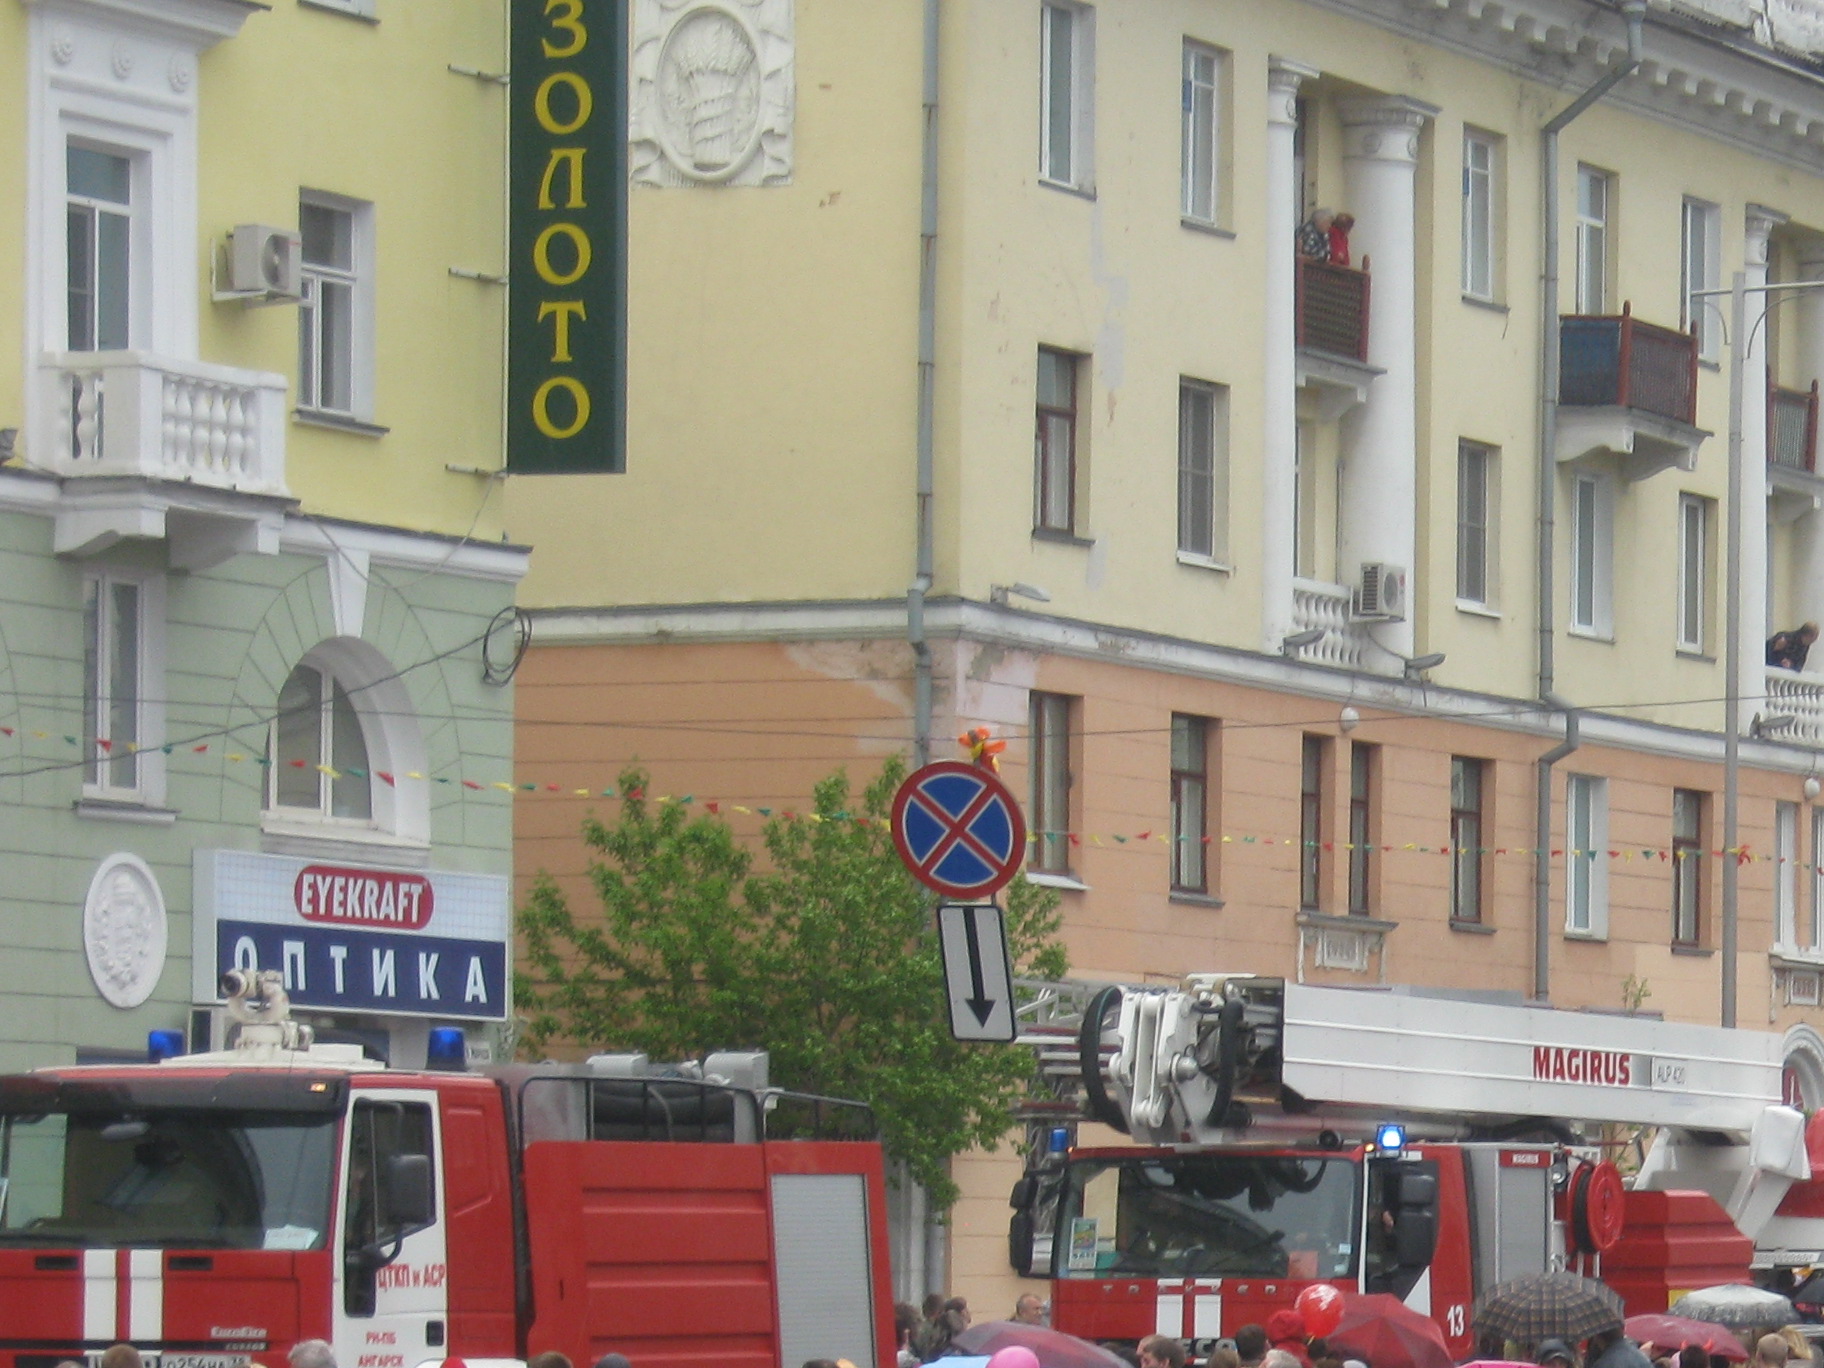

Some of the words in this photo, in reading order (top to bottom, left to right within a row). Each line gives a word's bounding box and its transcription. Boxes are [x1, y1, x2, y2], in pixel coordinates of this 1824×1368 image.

[533, 0, 592, 439] ЗОЛОТО
[301, 873, 423, 923] EYEKRAFT
[234, 935, 487, 1003] ОПТИКА
[1533, 1046, 1630, 1085] MAGIRUS
[1447, 1304, 1465, 1337] 13
[358, 1353, 404, 1368] АНГАРСК
